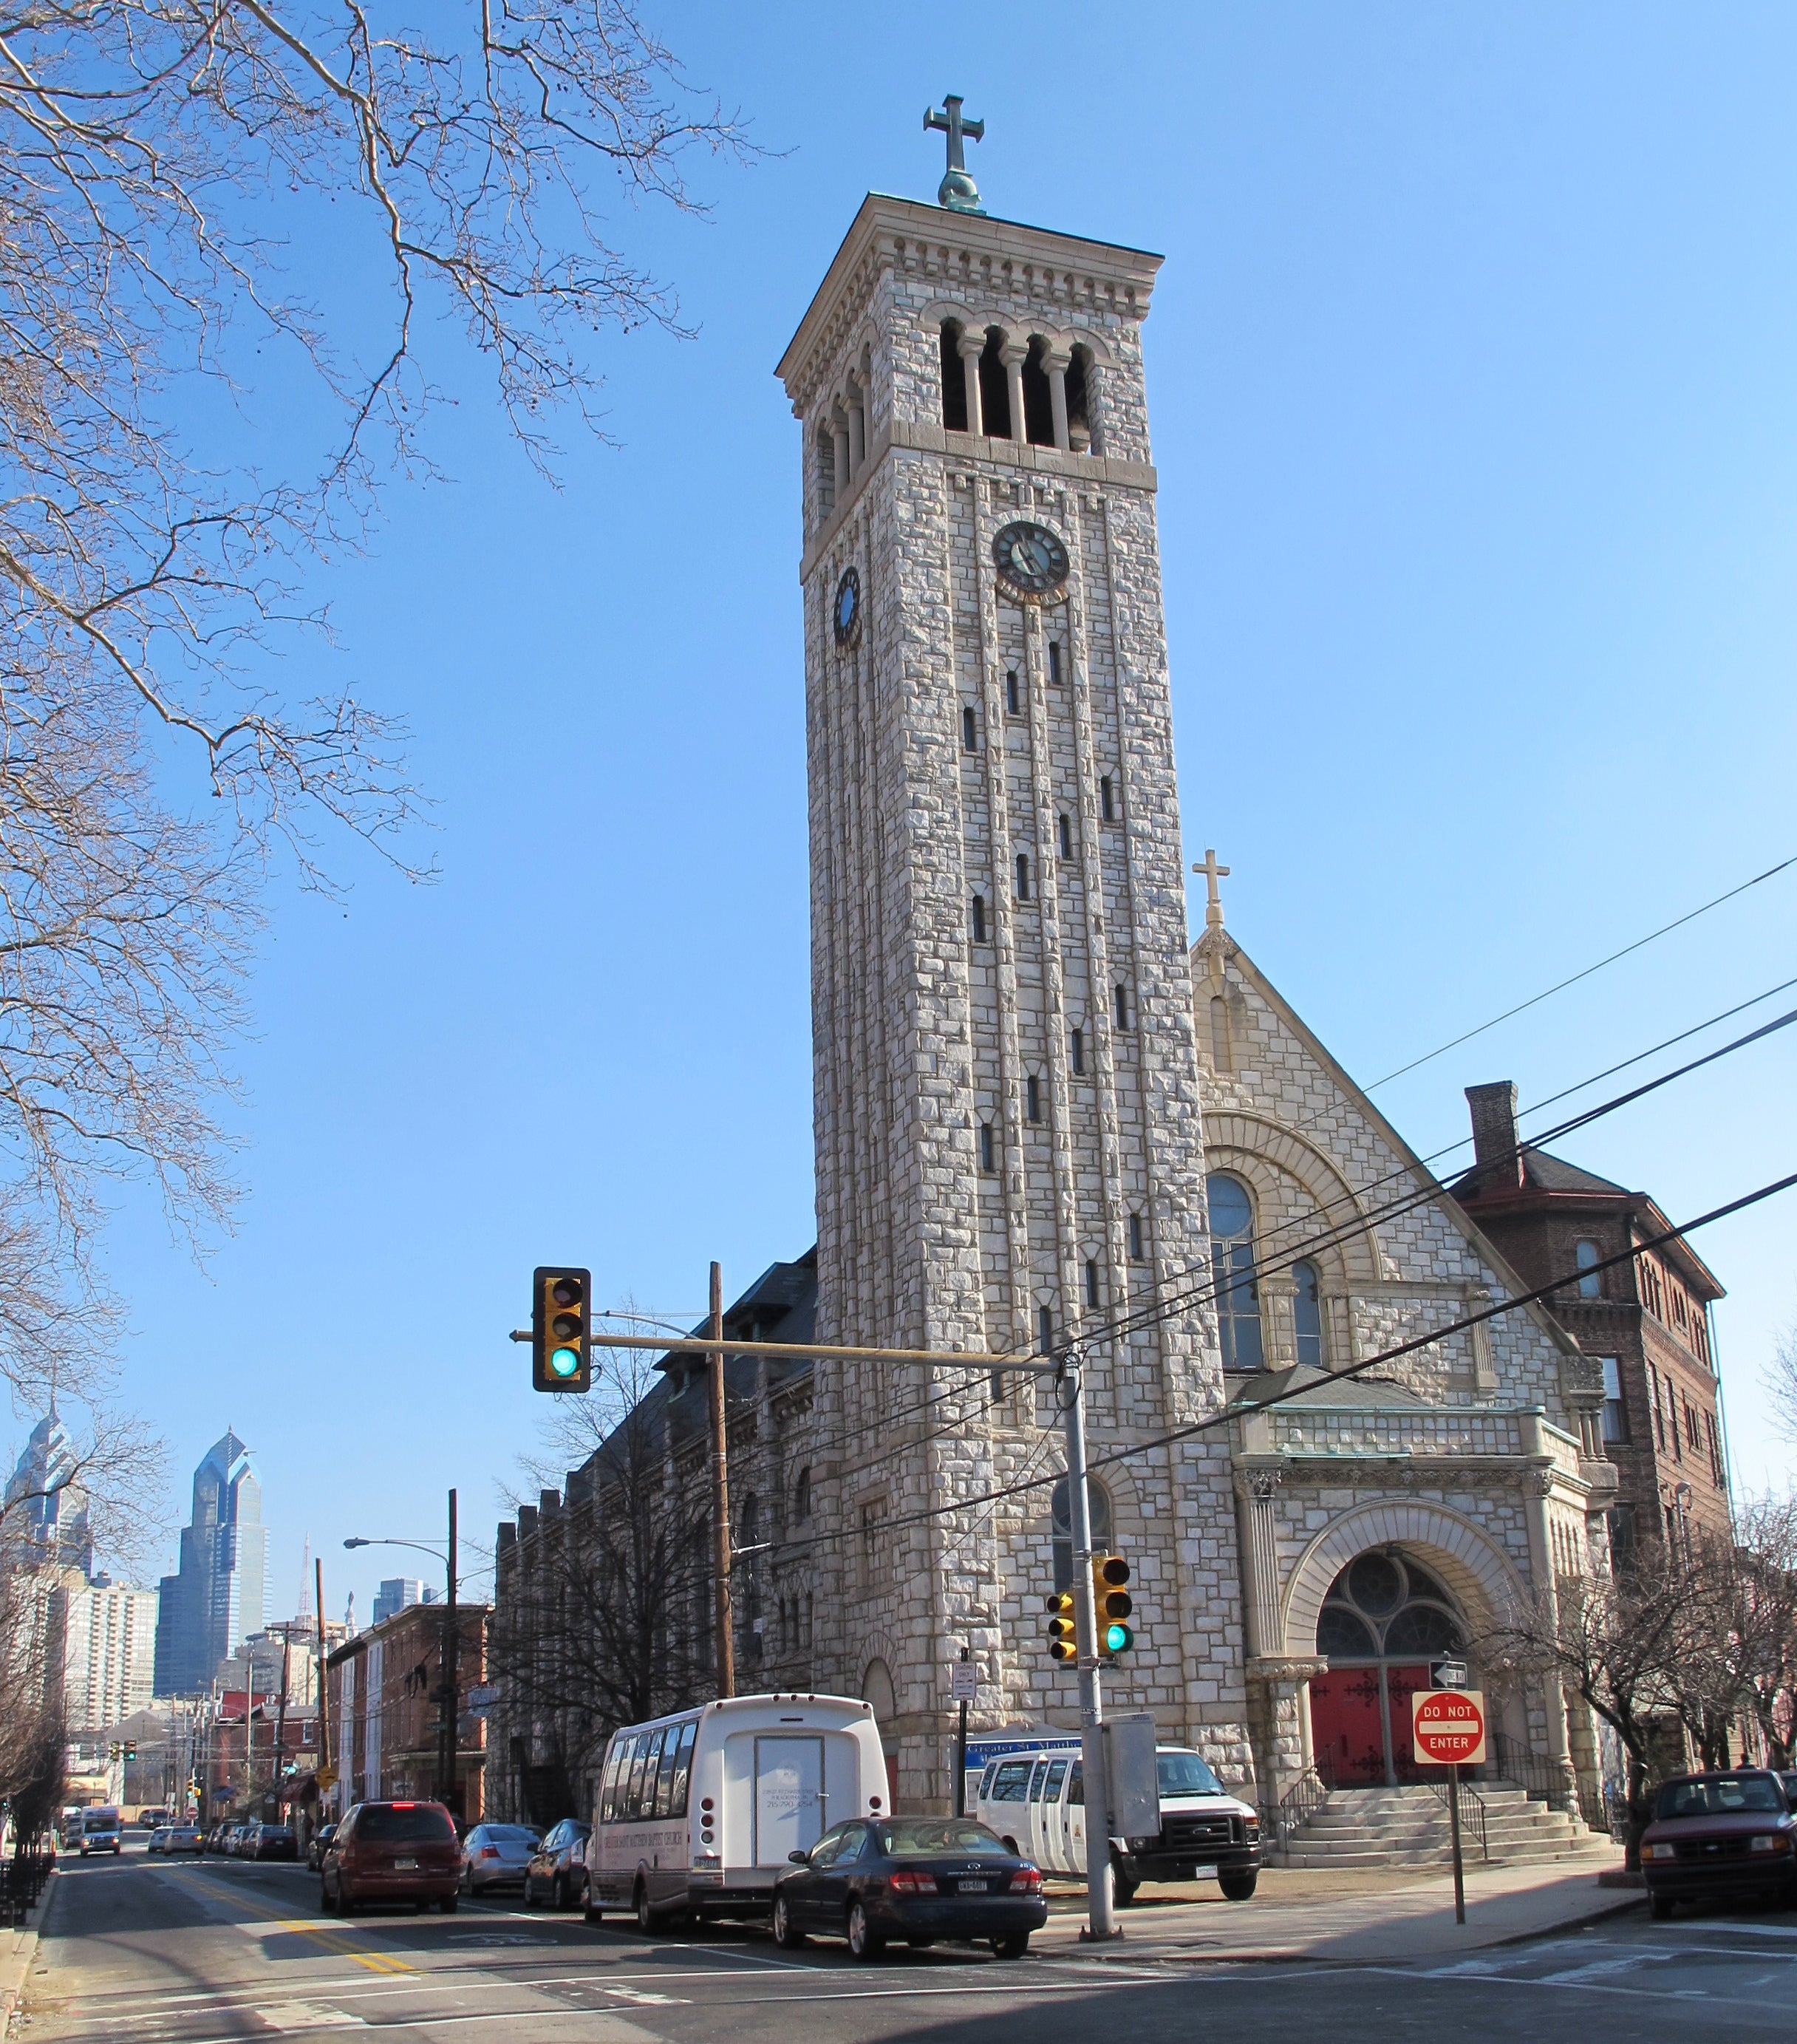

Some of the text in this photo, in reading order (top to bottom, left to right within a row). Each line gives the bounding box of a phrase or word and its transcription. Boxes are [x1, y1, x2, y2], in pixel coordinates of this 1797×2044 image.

[1424, 1706, 1472, 1717] DO NOT
[1430, 1737, 1469, 1748] ENTER
[664, 1831, 682, 1845] CHURCH
